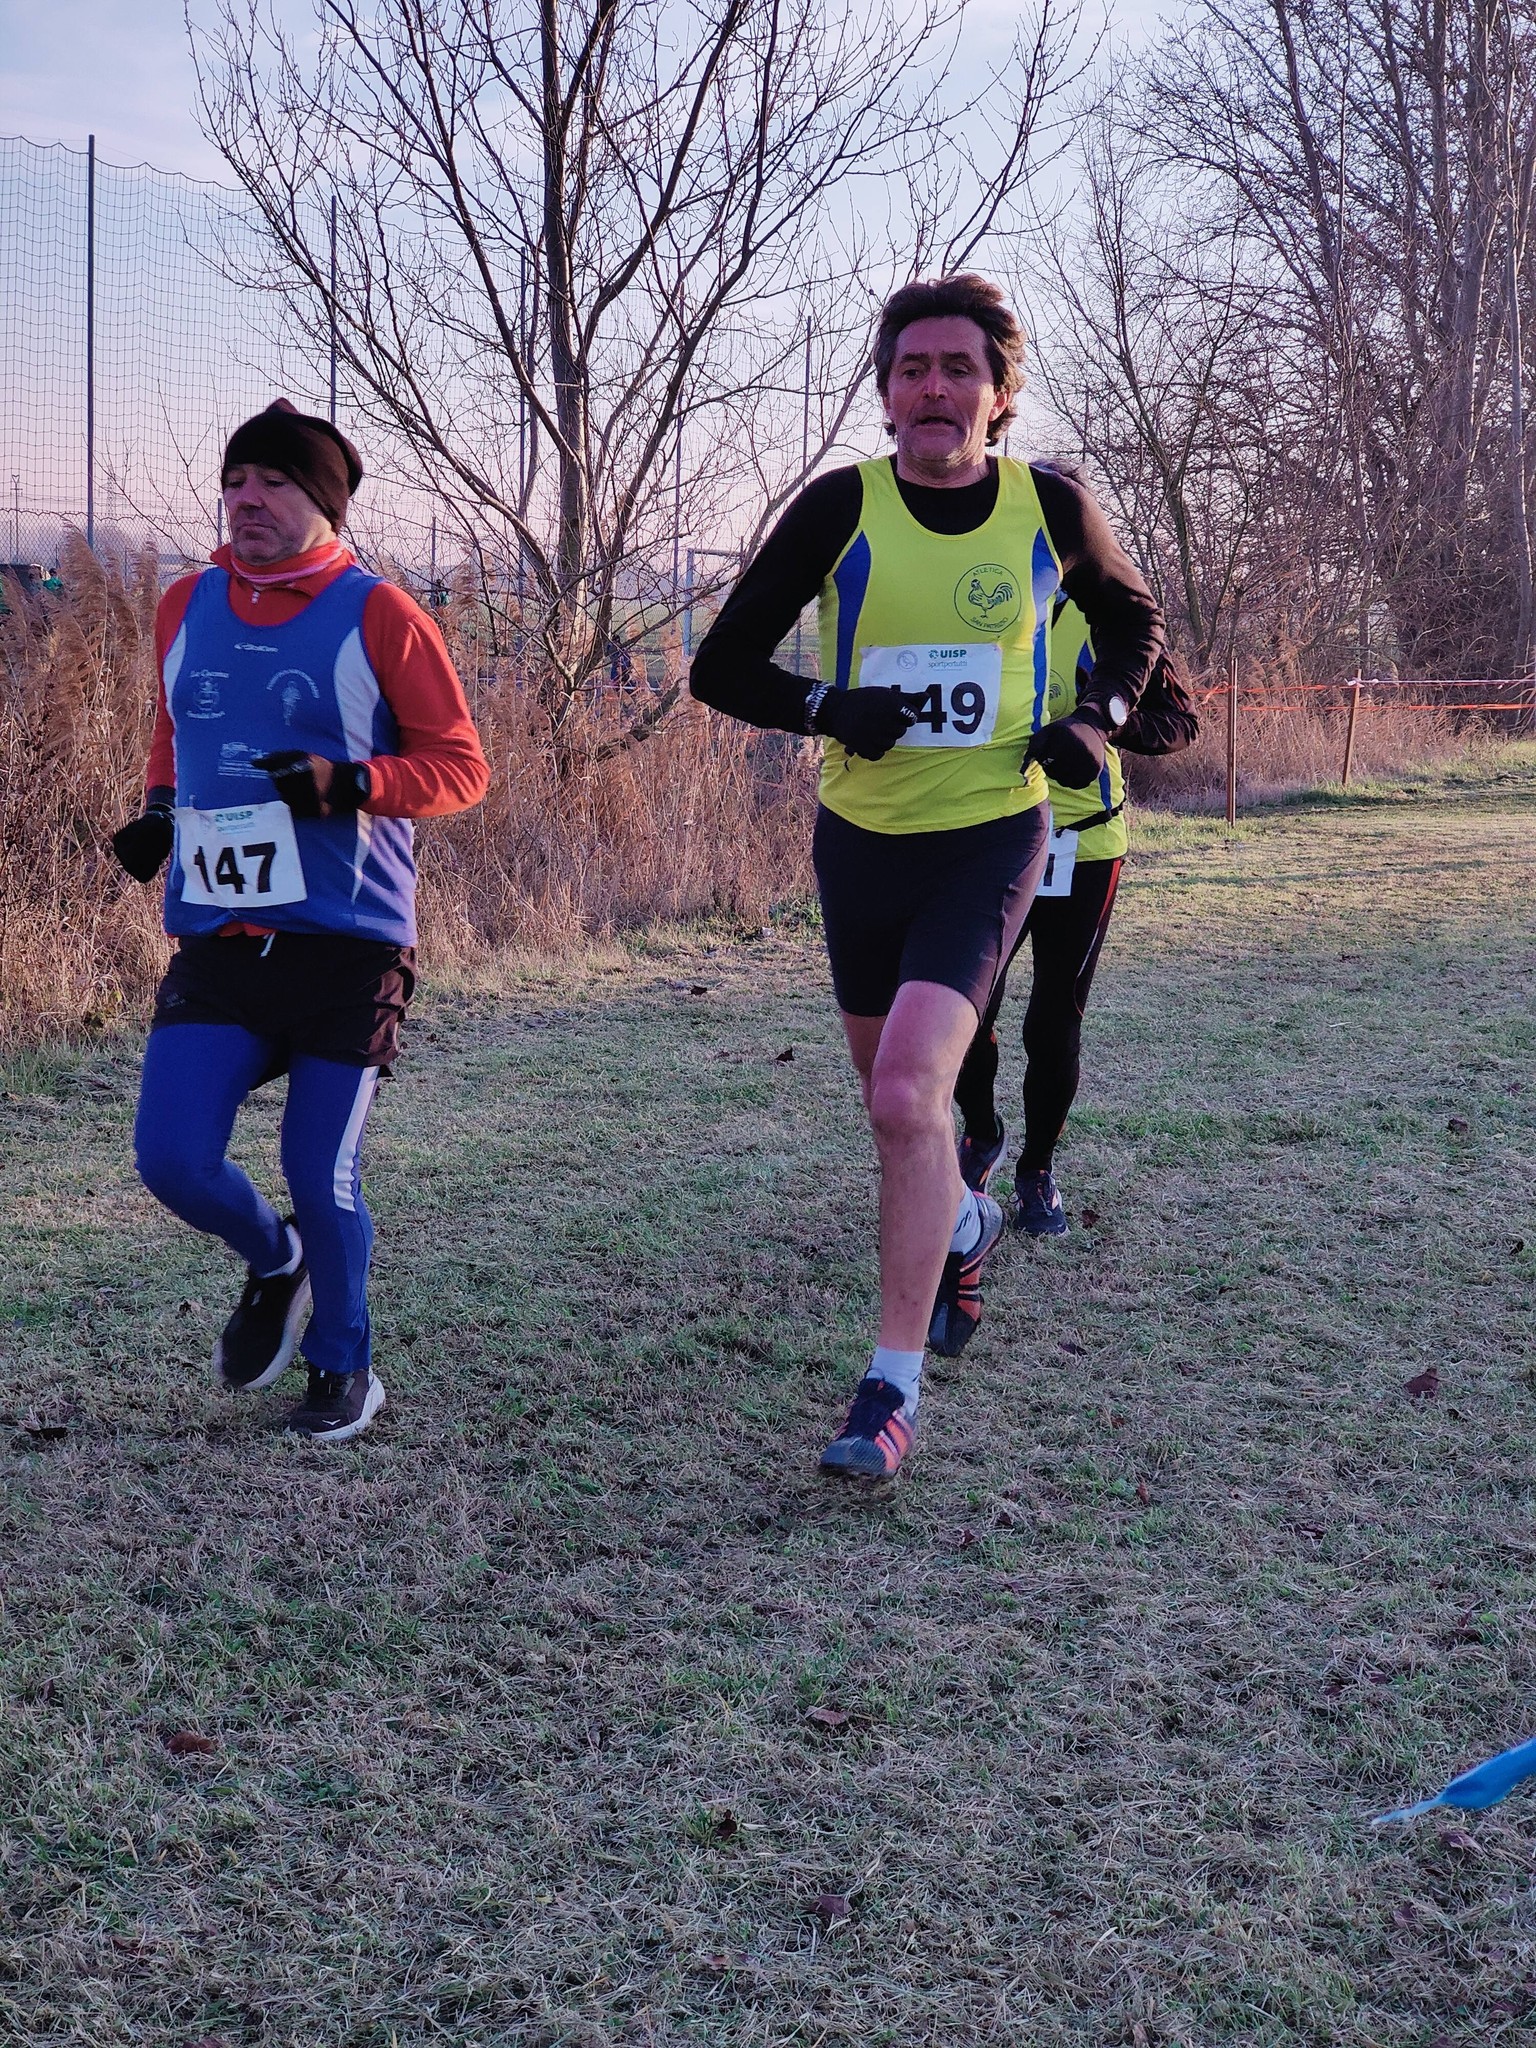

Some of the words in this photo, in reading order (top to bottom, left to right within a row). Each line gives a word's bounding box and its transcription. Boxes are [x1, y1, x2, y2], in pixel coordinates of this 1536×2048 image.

[940, 649, 967, 659] UISP
[890, 681, 986, 735] 49
[193, 841, 277, 895] 147
